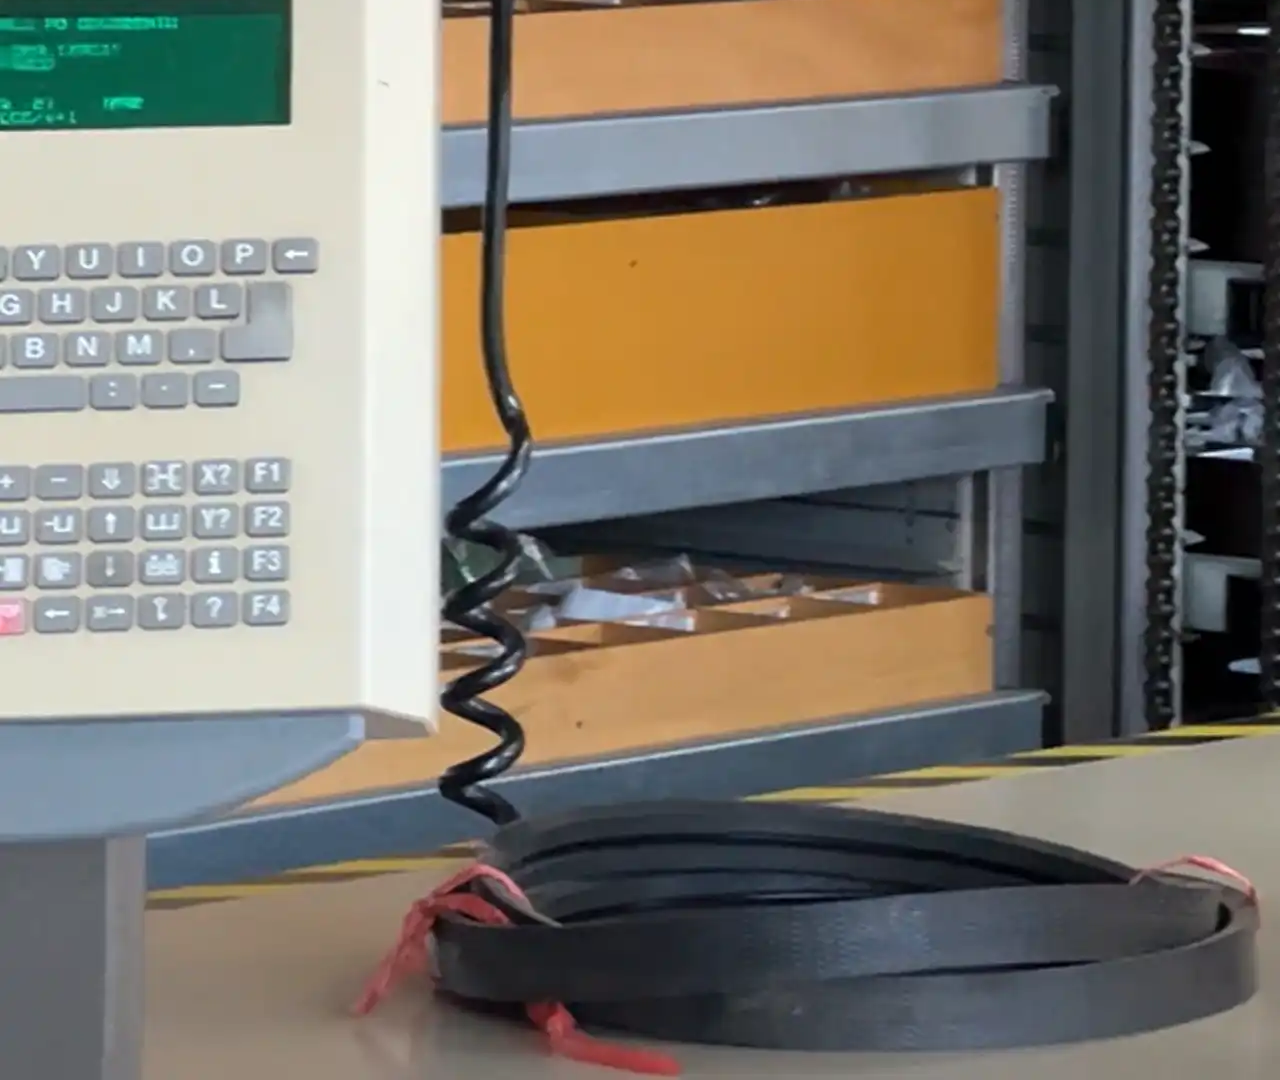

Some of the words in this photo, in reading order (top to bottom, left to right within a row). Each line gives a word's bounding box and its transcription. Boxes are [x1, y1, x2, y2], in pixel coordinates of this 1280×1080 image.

[26, 249, 46, 270] Y
[78, 248, 99, 270] U
[181, 244, 204, 267] O
[235, 243, 255, 264] P
[0, 293, 21, 316] G
[51, 293, 72, 314] H
[105, 291, 122, 313] J
[156, 289, 177, 311] K
[209, 288, 228, 310] L
[24, 336, 45, 359] B
[76, 336, 98, 357] N
[126, 334, 152, 355] M
[253, 462, 281, 483] F1
[253, 506, 284, 527] F2
[252, 550, 282, 572] F3
[251, 594, 282, 617] F4
